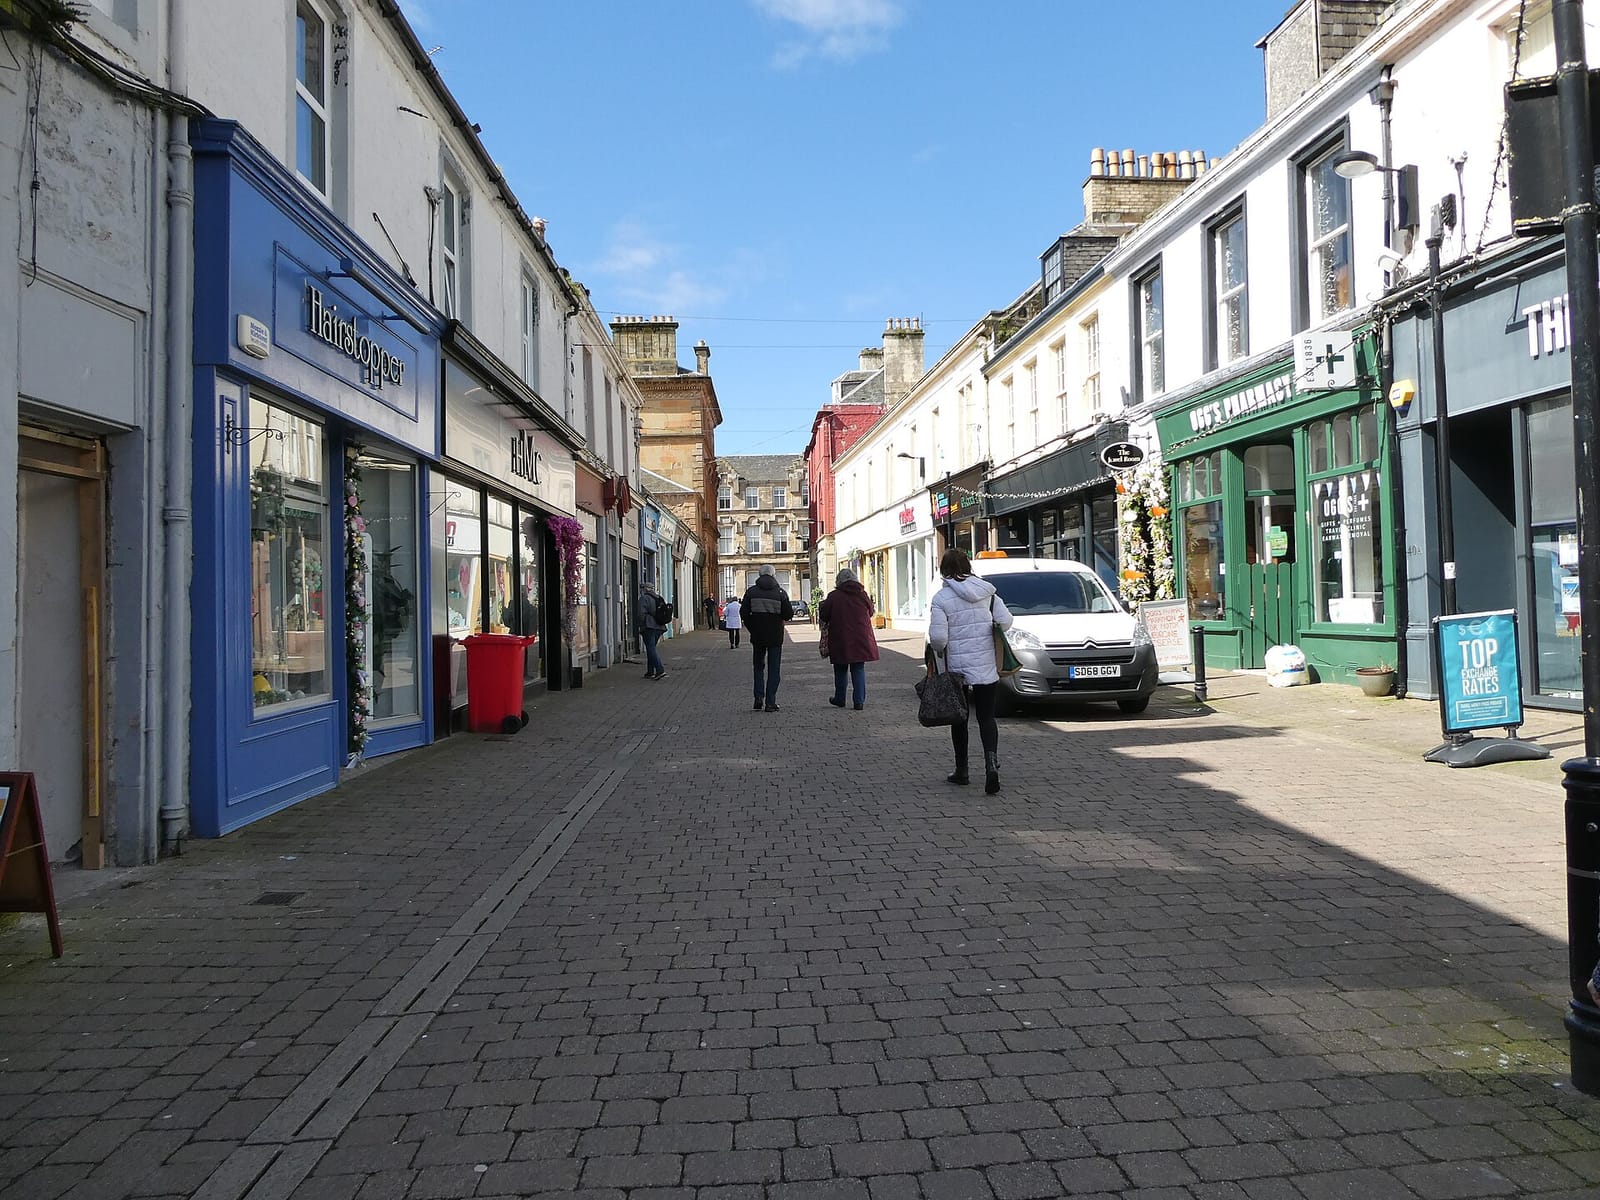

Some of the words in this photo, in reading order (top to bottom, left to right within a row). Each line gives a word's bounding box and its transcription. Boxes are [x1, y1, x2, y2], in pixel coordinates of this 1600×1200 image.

[309, 285, 405, 390] Hairstopper
[1304, 339, 1313, 361] 1836
[1189, 402, 1222, 431] OGG'S
[1223, 374, 1292, 419] PHARMACY
[1343, 515, 1371, 525] PERFUMES
[1458, 638, 1498, 669] TOP
[1074, 666, 1099, 676] SD68
[1100, 666, 1118, 675] GGV
[1461, 666, 1498, 680] EXCHANGE
[1462, 677, 1499, 695] RATES
